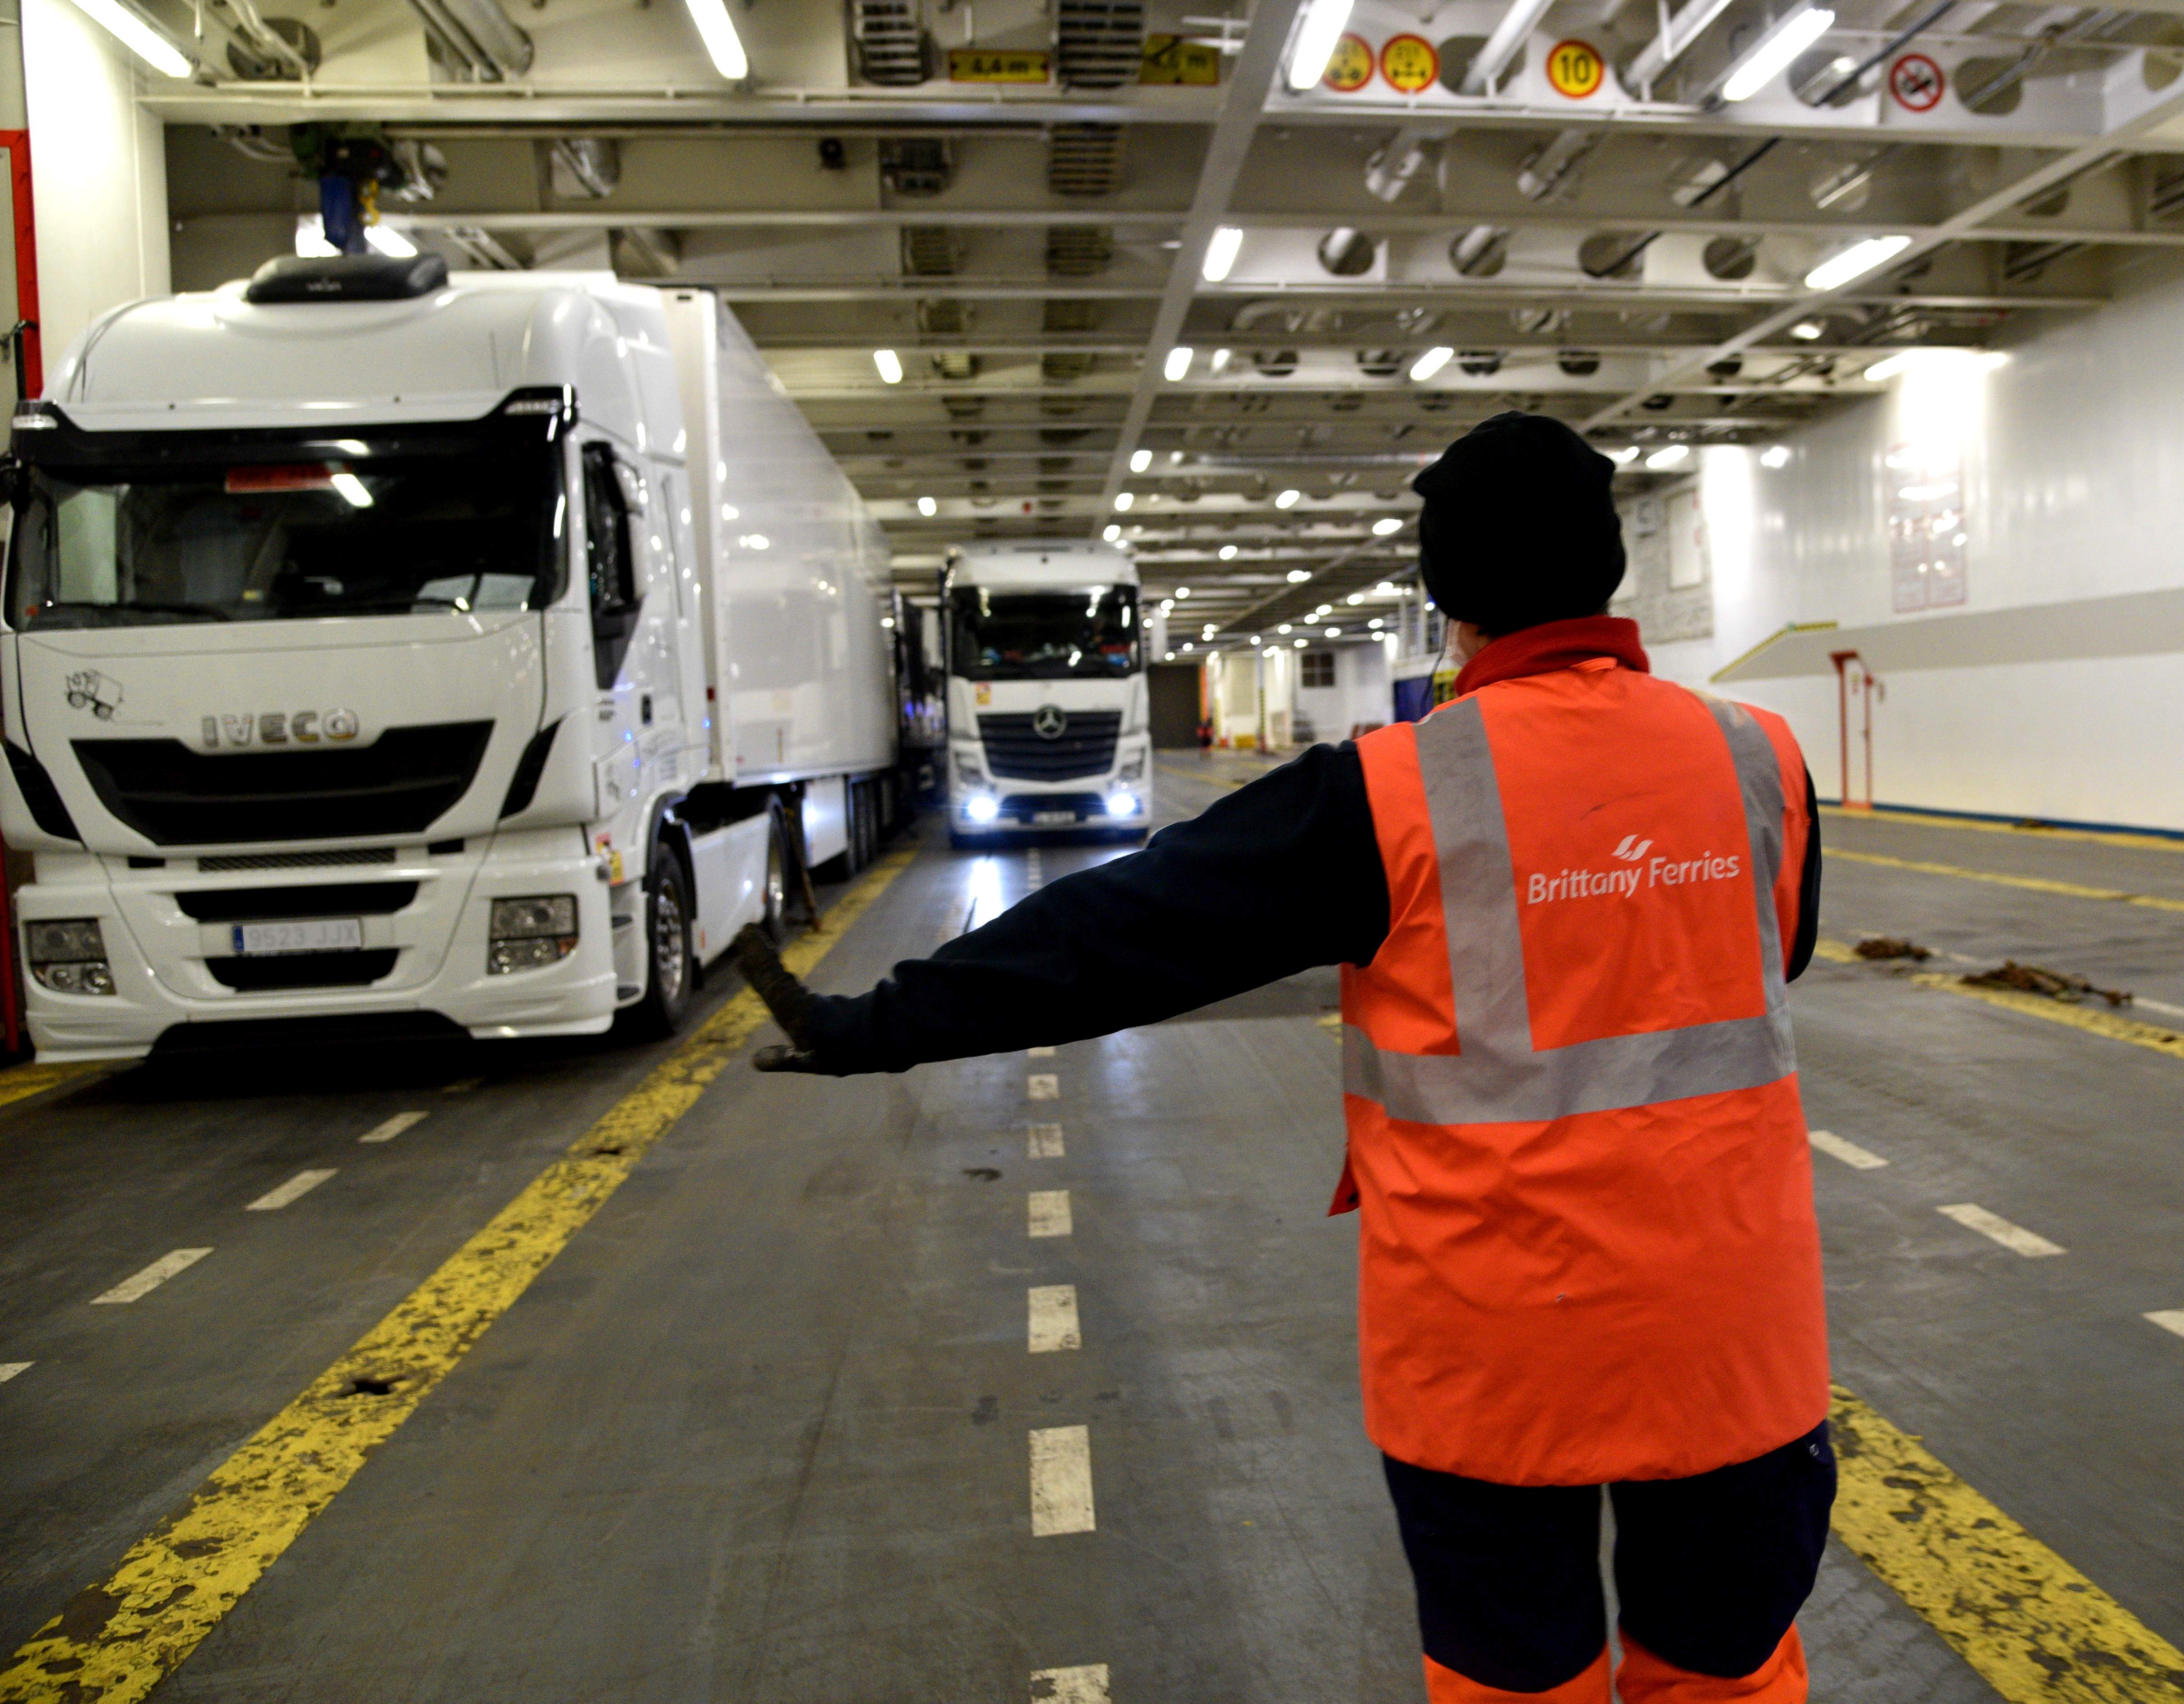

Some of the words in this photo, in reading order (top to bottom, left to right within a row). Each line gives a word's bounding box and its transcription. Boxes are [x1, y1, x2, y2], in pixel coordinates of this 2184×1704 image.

[1561, 53, 1591, 84] 10
[201, 708, 360, 747] IVECO
[1527, 867, 1643, 905] Brittany
[1648, 850, 1740, 889] Ferries
